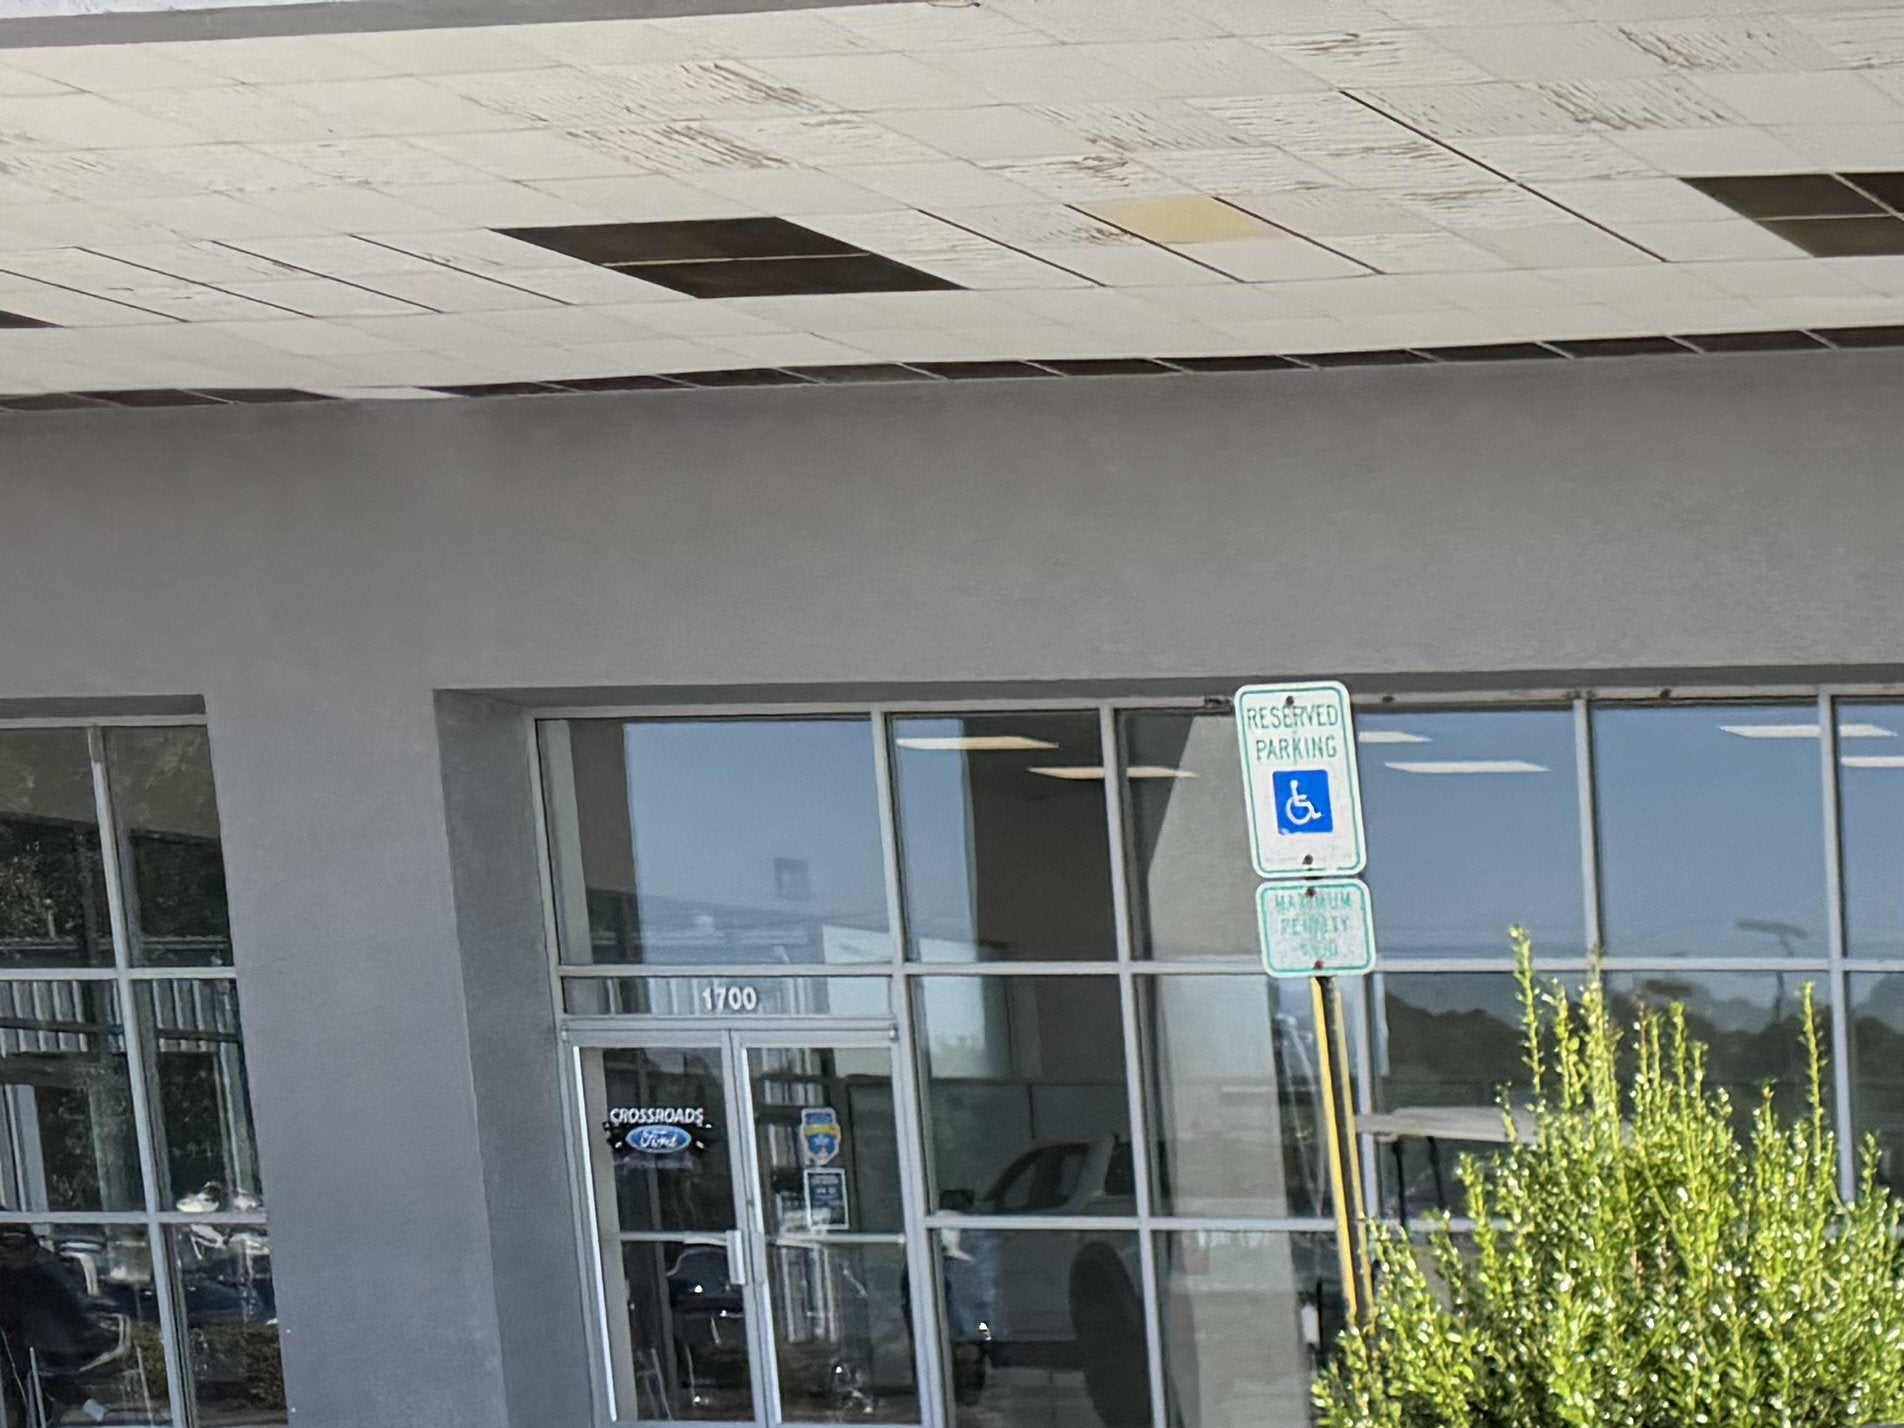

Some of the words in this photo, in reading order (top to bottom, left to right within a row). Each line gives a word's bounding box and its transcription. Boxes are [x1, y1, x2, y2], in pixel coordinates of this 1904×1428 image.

[1246, 704, 1339, 730] RESERVED
[1255, 735, 1338, 762] PARKING
[702, 985, 758, 1012] 1700
[609, 1107, 705, 1127] CROSSROADS
